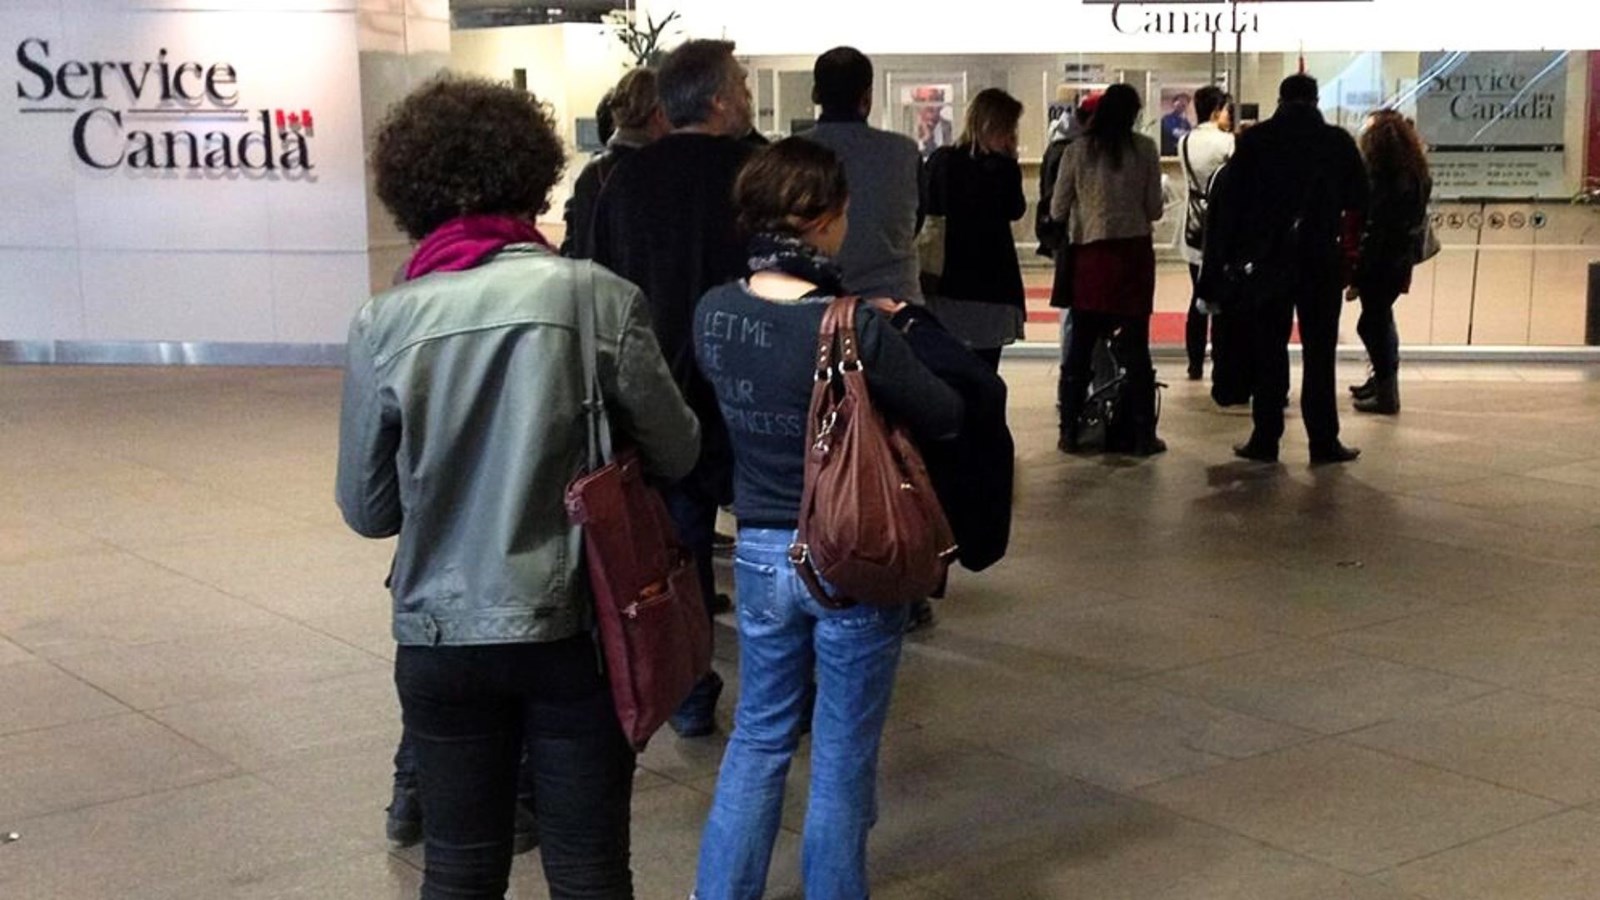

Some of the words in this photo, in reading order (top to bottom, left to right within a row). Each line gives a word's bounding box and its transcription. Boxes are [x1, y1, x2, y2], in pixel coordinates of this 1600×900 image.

[1111, 2, 1259, 35] Canada
[16, 37, 238, 101] Service
[1428, 68, 1526, 93] Service
[1450, 93, 1554, 121] Canada
[72, 107, 314, 170] Canada
[704, 311, 738, 341] LET
[740, 316, 774, 348] ME
[719, 402, 801, 437] PNCESS
